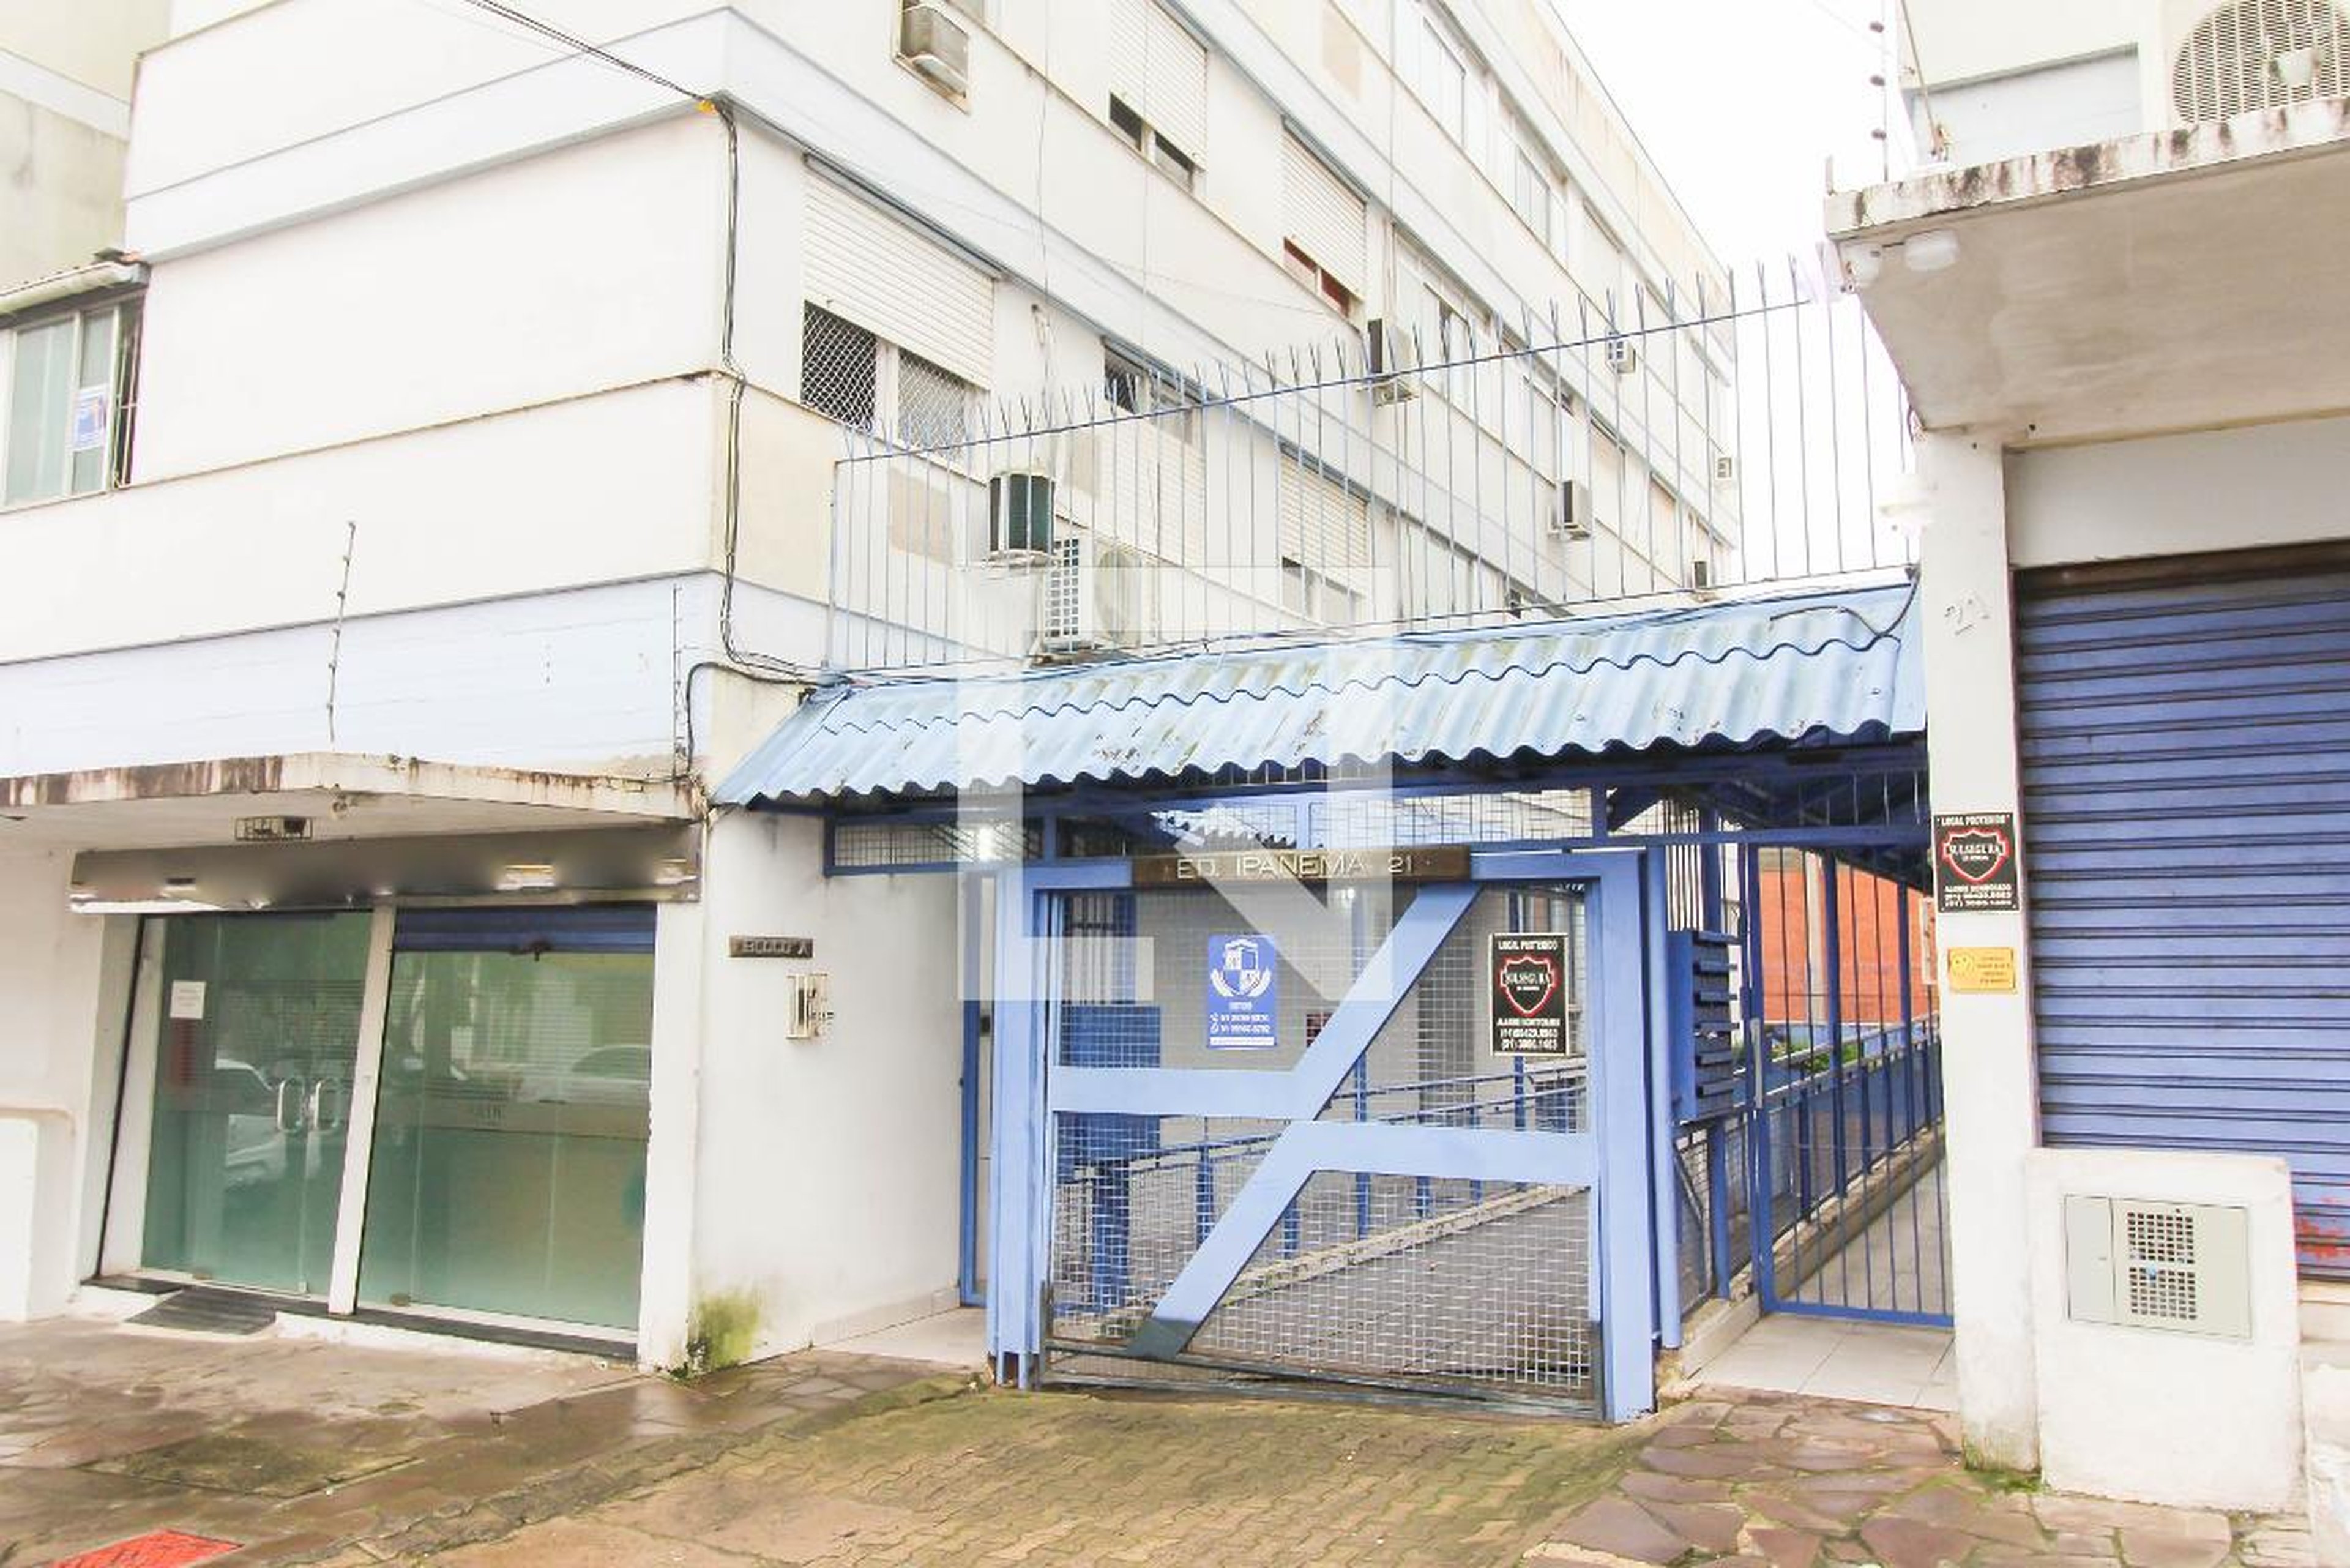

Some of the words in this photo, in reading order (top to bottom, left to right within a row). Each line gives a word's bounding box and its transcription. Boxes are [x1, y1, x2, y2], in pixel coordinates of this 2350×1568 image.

[1177, 858, 1220, 879] ED.
[1236, 853, 1367, 879] IPANEMA
[1387, 855, 1413, 873] 21
